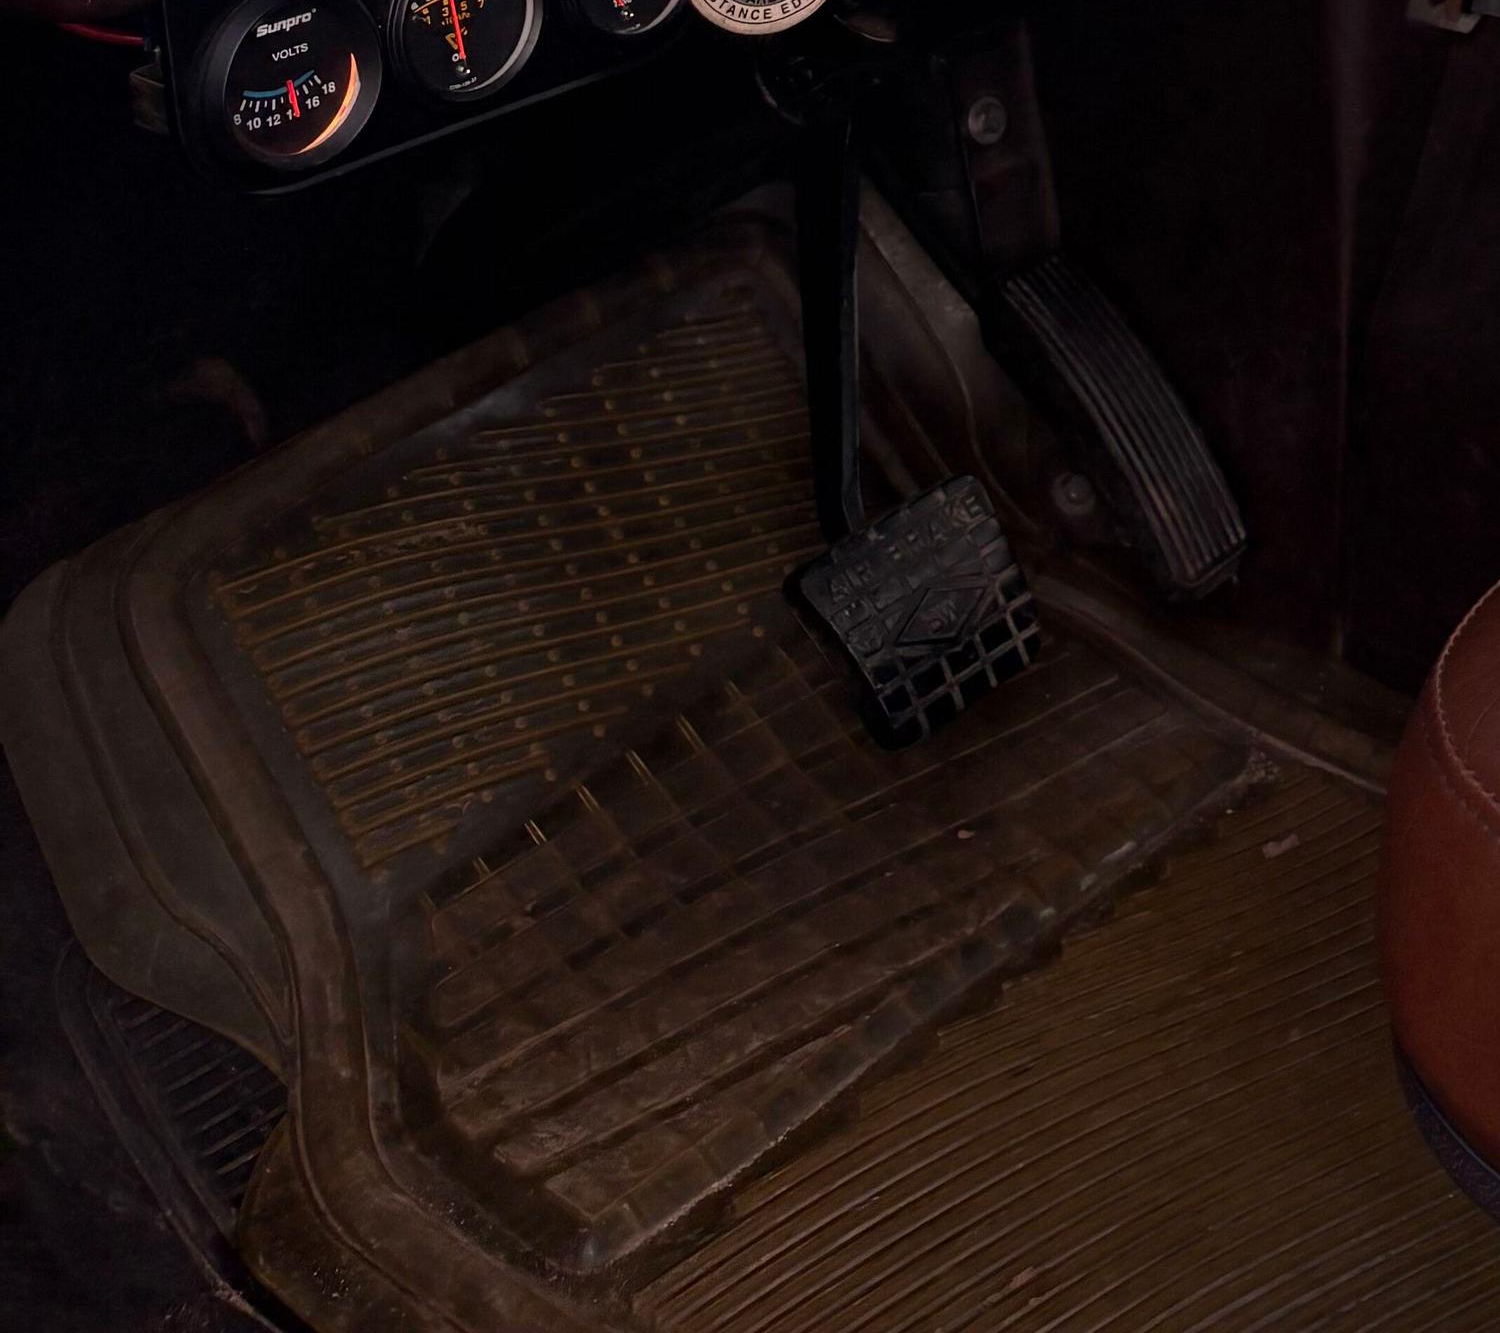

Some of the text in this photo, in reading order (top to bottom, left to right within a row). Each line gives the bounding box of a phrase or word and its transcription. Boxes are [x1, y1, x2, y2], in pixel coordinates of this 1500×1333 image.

[256, 11, 313, 38] Sunpro
[271, 42, 310, 62] VOLTS
[246, 116, 262, 132] 10
[265, 112, 282, 128] 12
[305, 94, 321, 110] 16
[321, 80, 337, 96] 18
